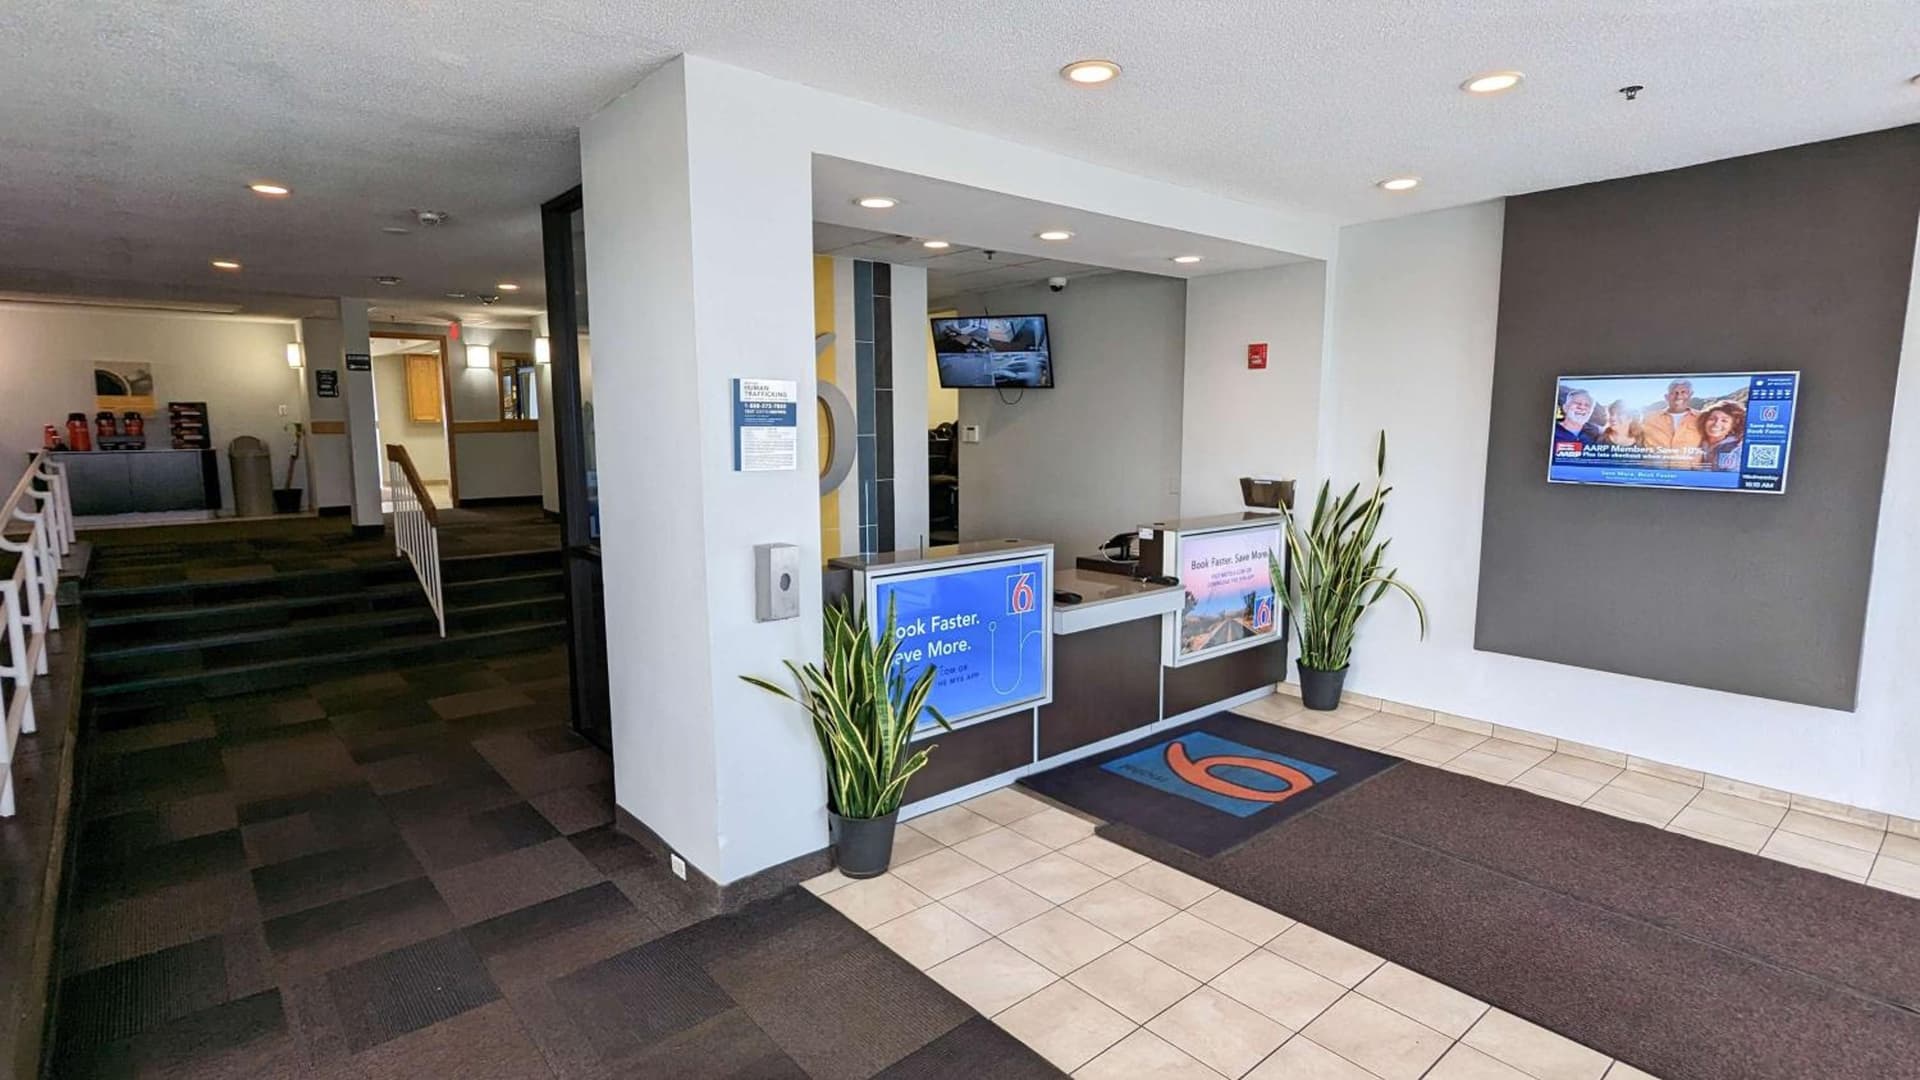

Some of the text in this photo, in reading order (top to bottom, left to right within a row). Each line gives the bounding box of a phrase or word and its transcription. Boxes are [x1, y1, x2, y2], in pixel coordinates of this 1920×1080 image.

[1583, 444, 1609, 452] AARP
[1610, 445, 1653, 453] Members
[1656, 446, 1680, 454] Save
[1191, 559, 1209, 570] Book
[1235, 553, 1250, 563] Save
[1012, 573, 1034, 614] 6
[896, 613, 980, 639] ook Faster.
[891, 640, 971, 665] ave More.
[958, 664, 968, 672] OR
[966, 671, 980, 680] APP
[1164, 740, 1316, 803] 6
